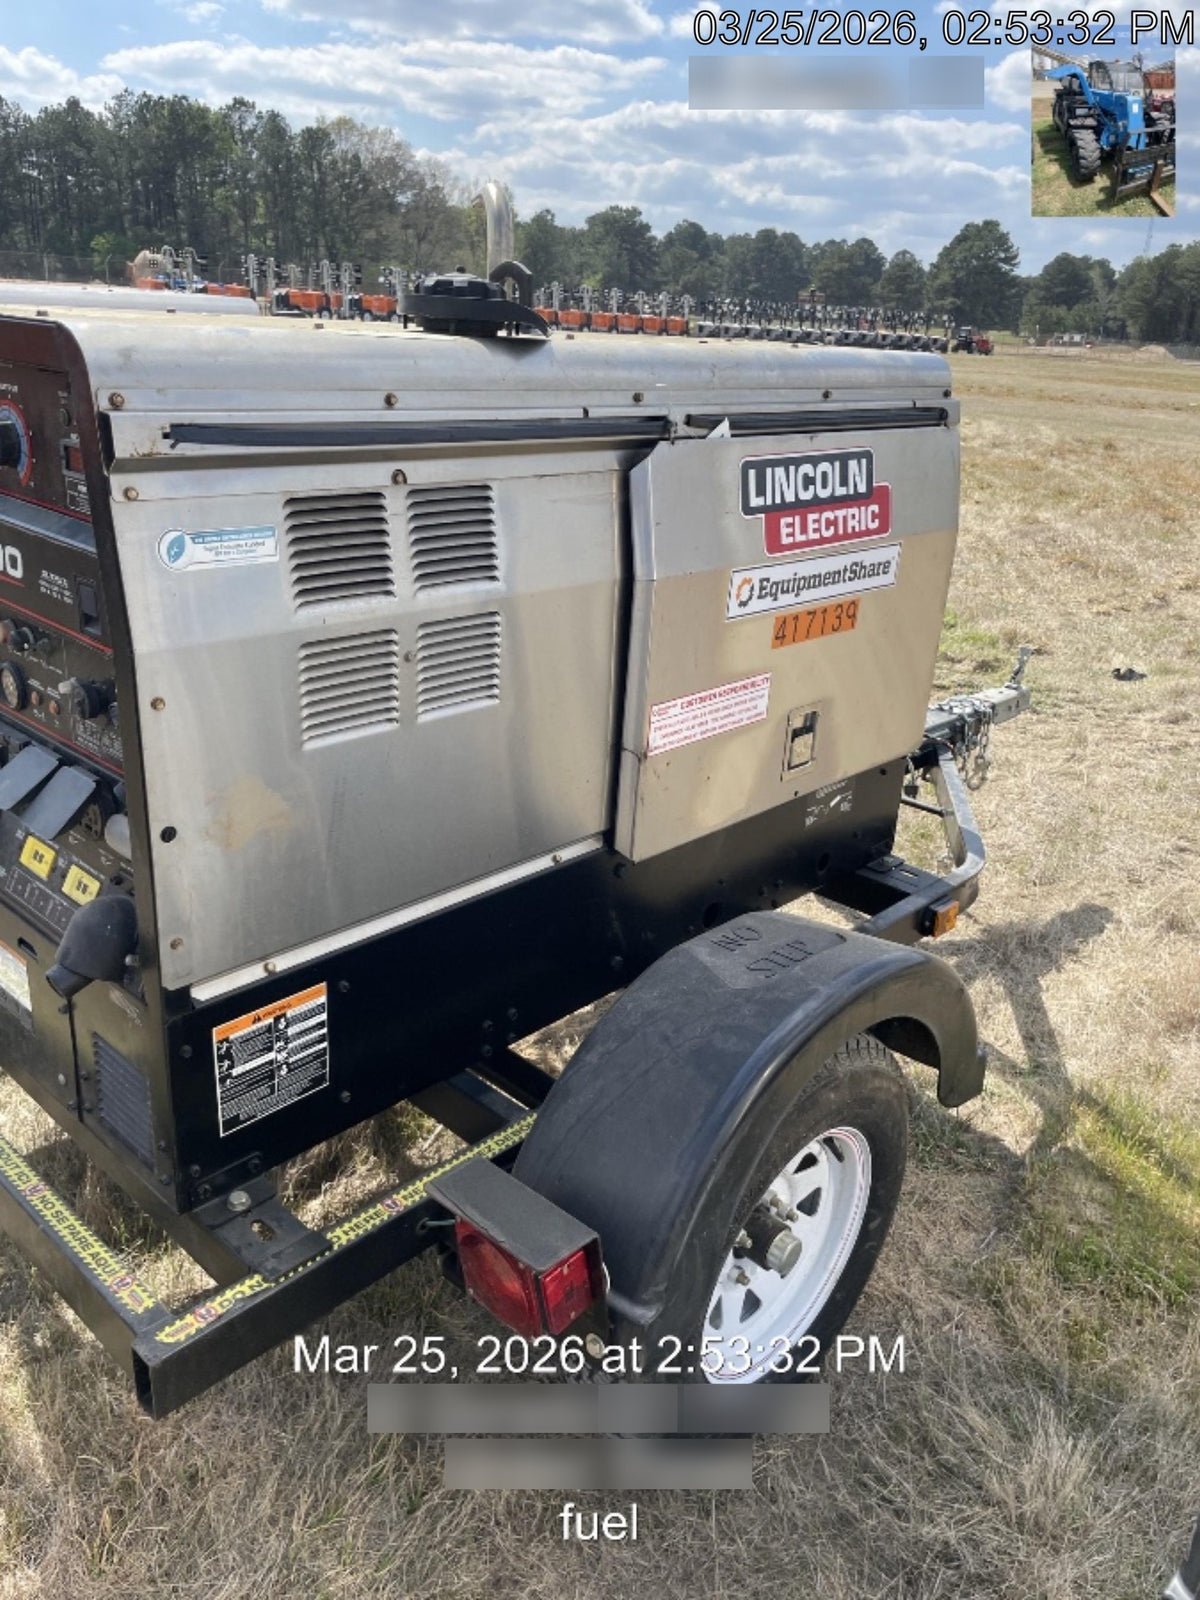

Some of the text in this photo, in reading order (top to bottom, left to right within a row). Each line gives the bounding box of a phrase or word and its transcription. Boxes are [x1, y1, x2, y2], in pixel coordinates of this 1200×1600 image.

[748, 457, 868, 508] LINCOLN
[779, 503, 880, 545] ELECTRIC
[0, 543, 24, 579] 0
[757, 558, 891, 601] EquipmentShare
[773, 600, 859, 646] 417139
[710, 927, 762, 952] NO
[746, 939, 814, 979] STEP
